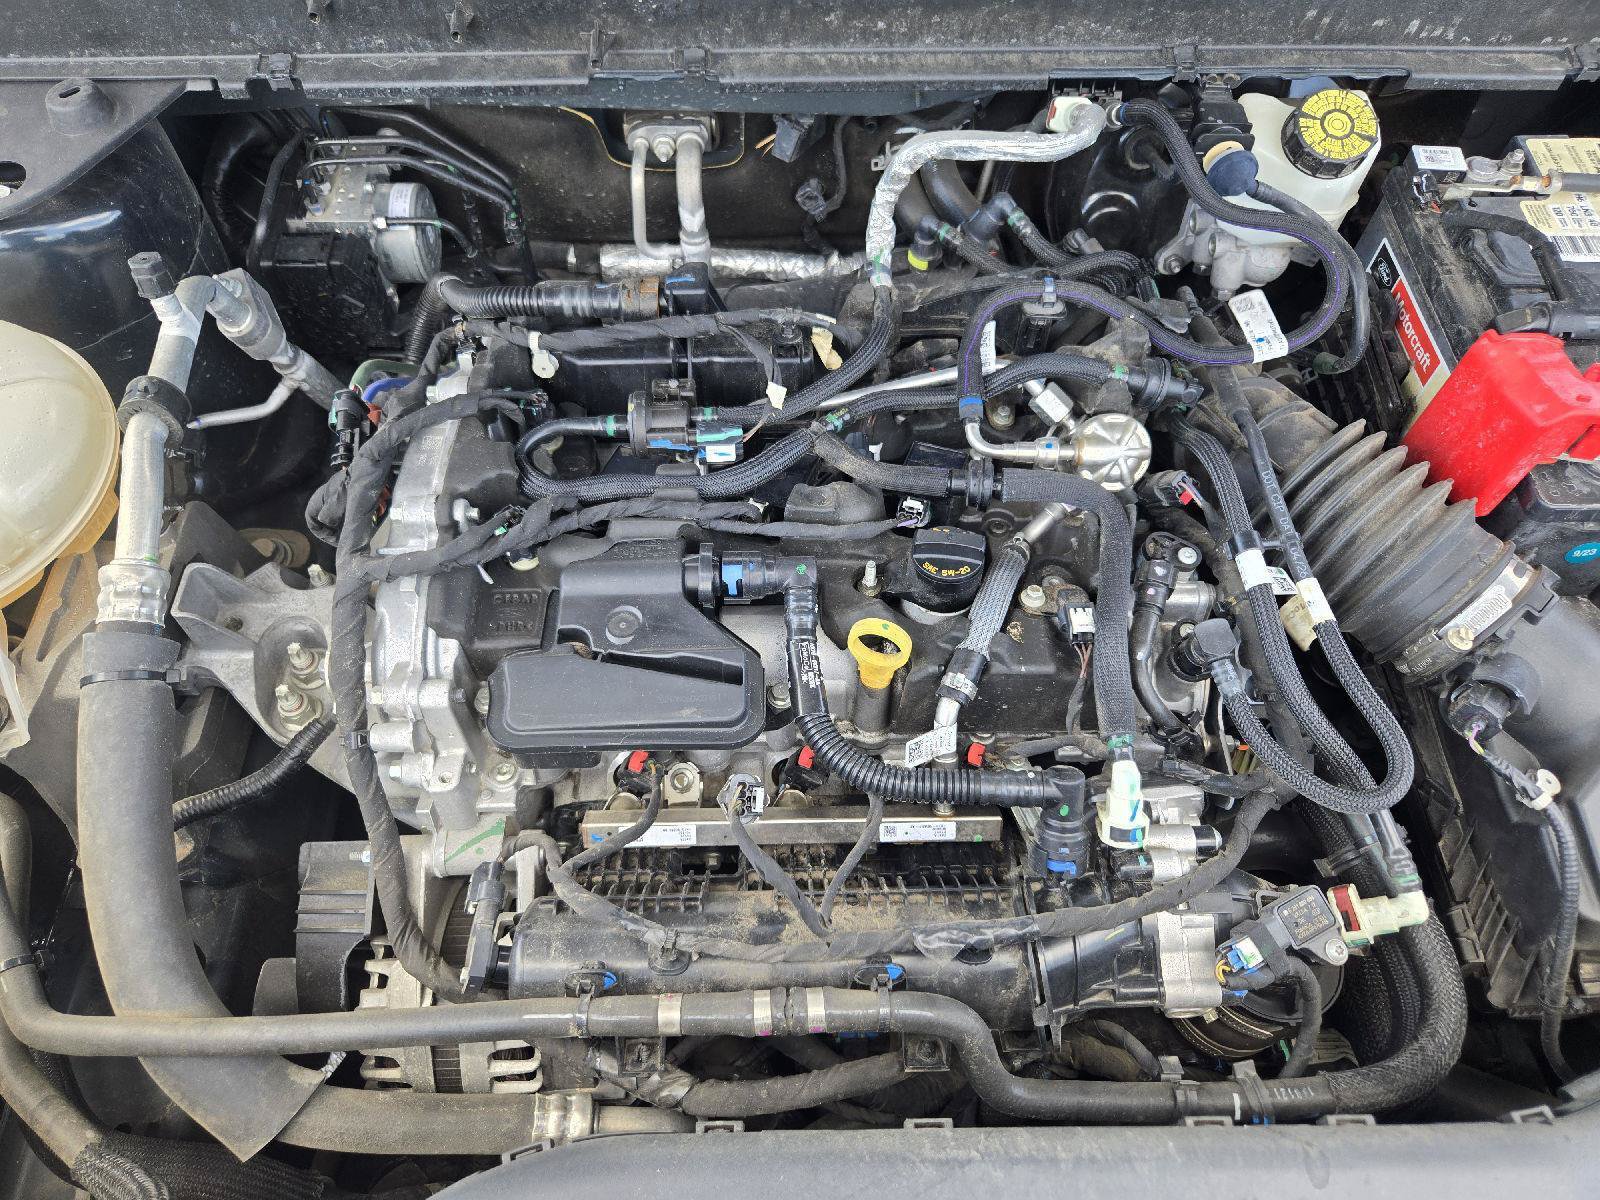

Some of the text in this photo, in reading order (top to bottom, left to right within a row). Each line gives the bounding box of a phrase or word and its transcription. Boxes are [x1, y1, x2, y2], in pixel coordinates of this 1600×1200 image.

[1394, 291, 1431, 374] Motorcraft
[1573, 548, 1598, 558] 9/23
[922, 561, 971, 577] SAE 5W-20
